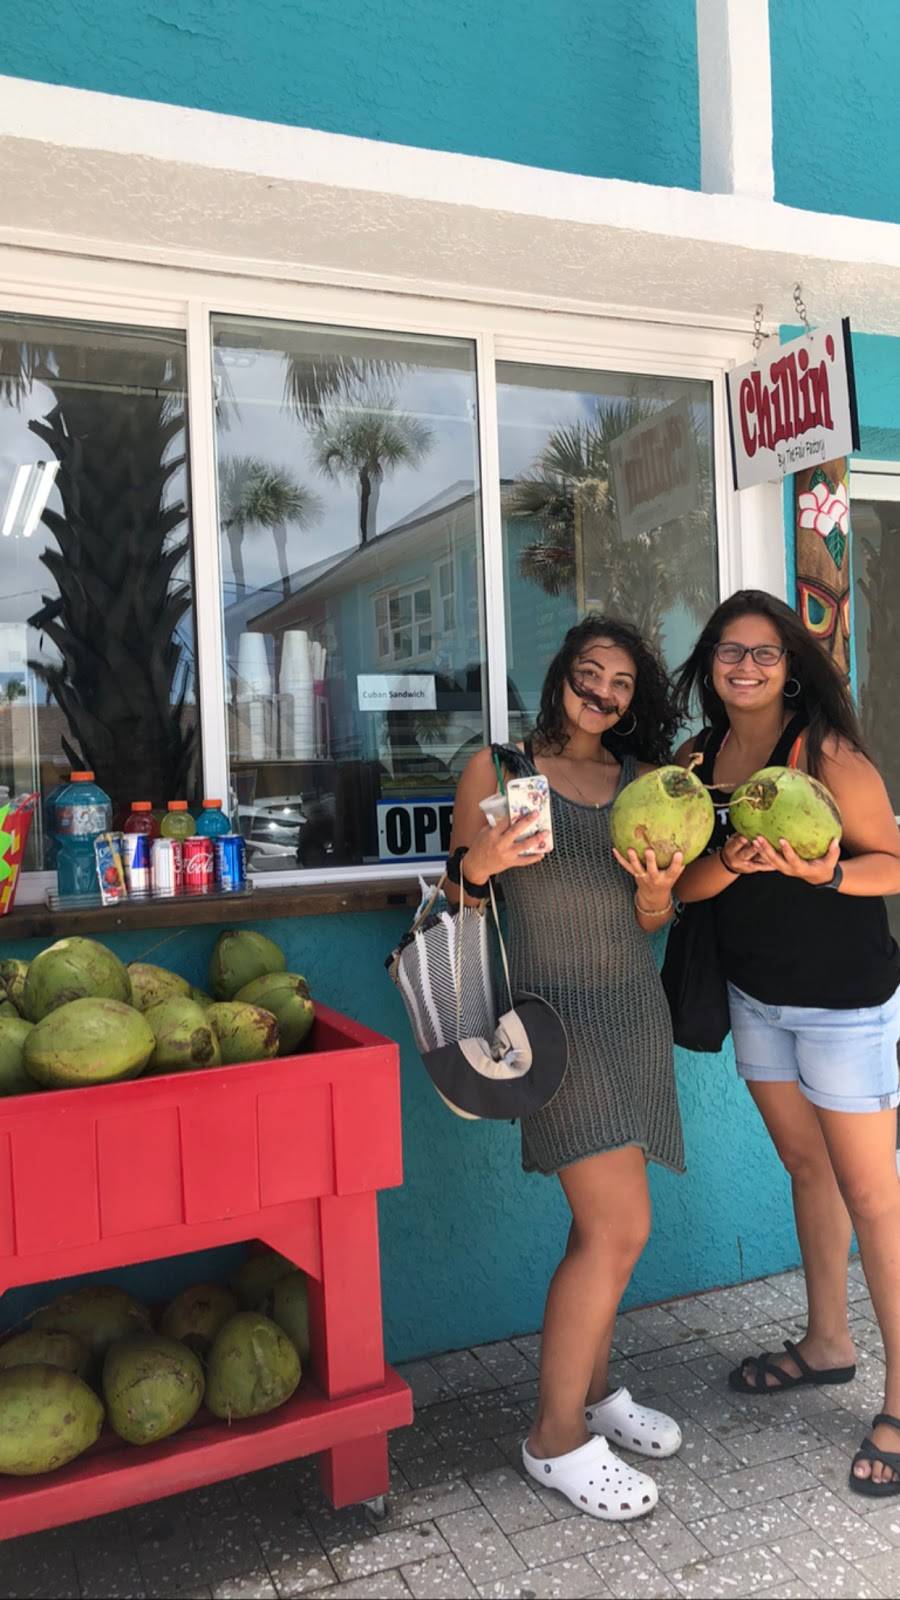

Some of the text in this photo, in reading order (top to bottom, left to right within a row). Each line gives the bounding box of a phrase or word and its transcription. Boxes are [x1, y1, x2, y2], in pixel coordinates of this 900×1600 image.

[740, 335, 834, 457] Chillin'
[362, 690, 425, 699] Cuban Sandwich
[385, 805, 455, 856] OPE
